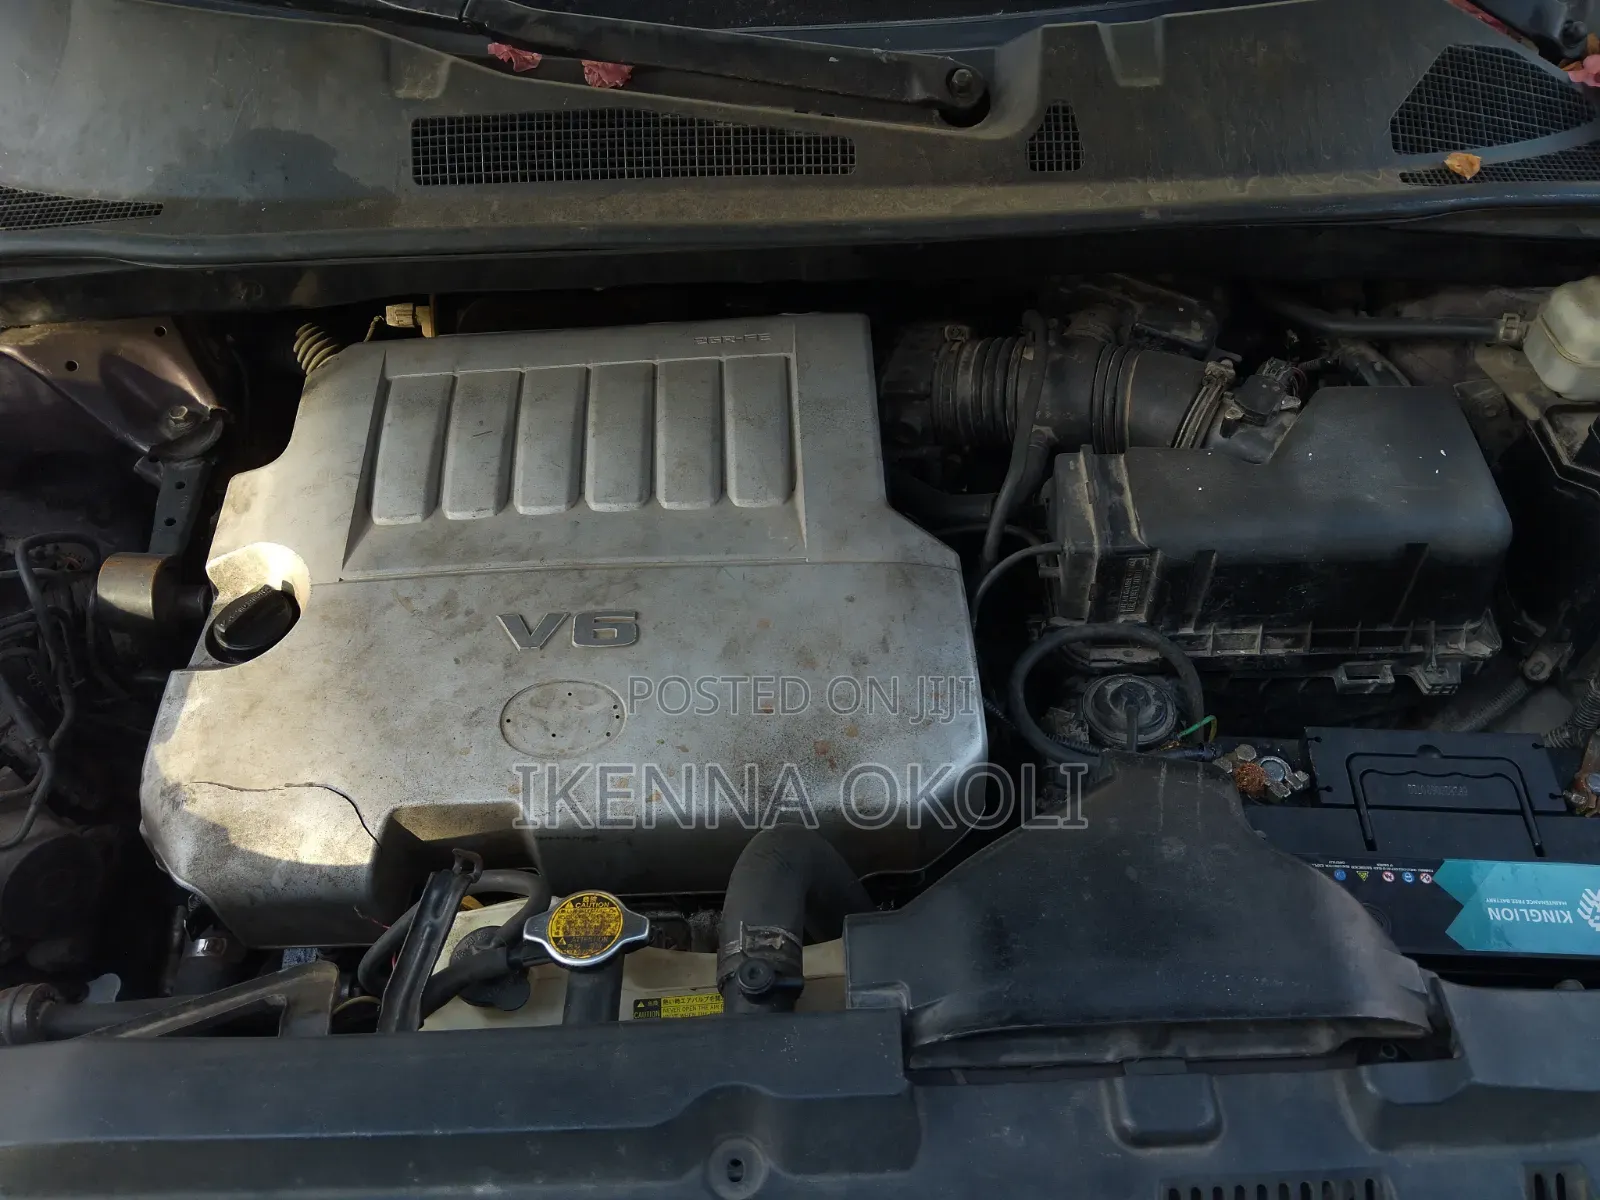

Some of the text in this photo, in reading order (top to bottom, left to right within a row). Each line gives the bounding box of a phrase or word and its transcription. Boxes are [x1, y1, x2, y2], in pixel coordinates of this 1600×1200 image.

[496, 611, 639, 651] V6
[1488, 906, 1574, 924] KINGLION
[633, 1010, 660, 1019] CAUTION
